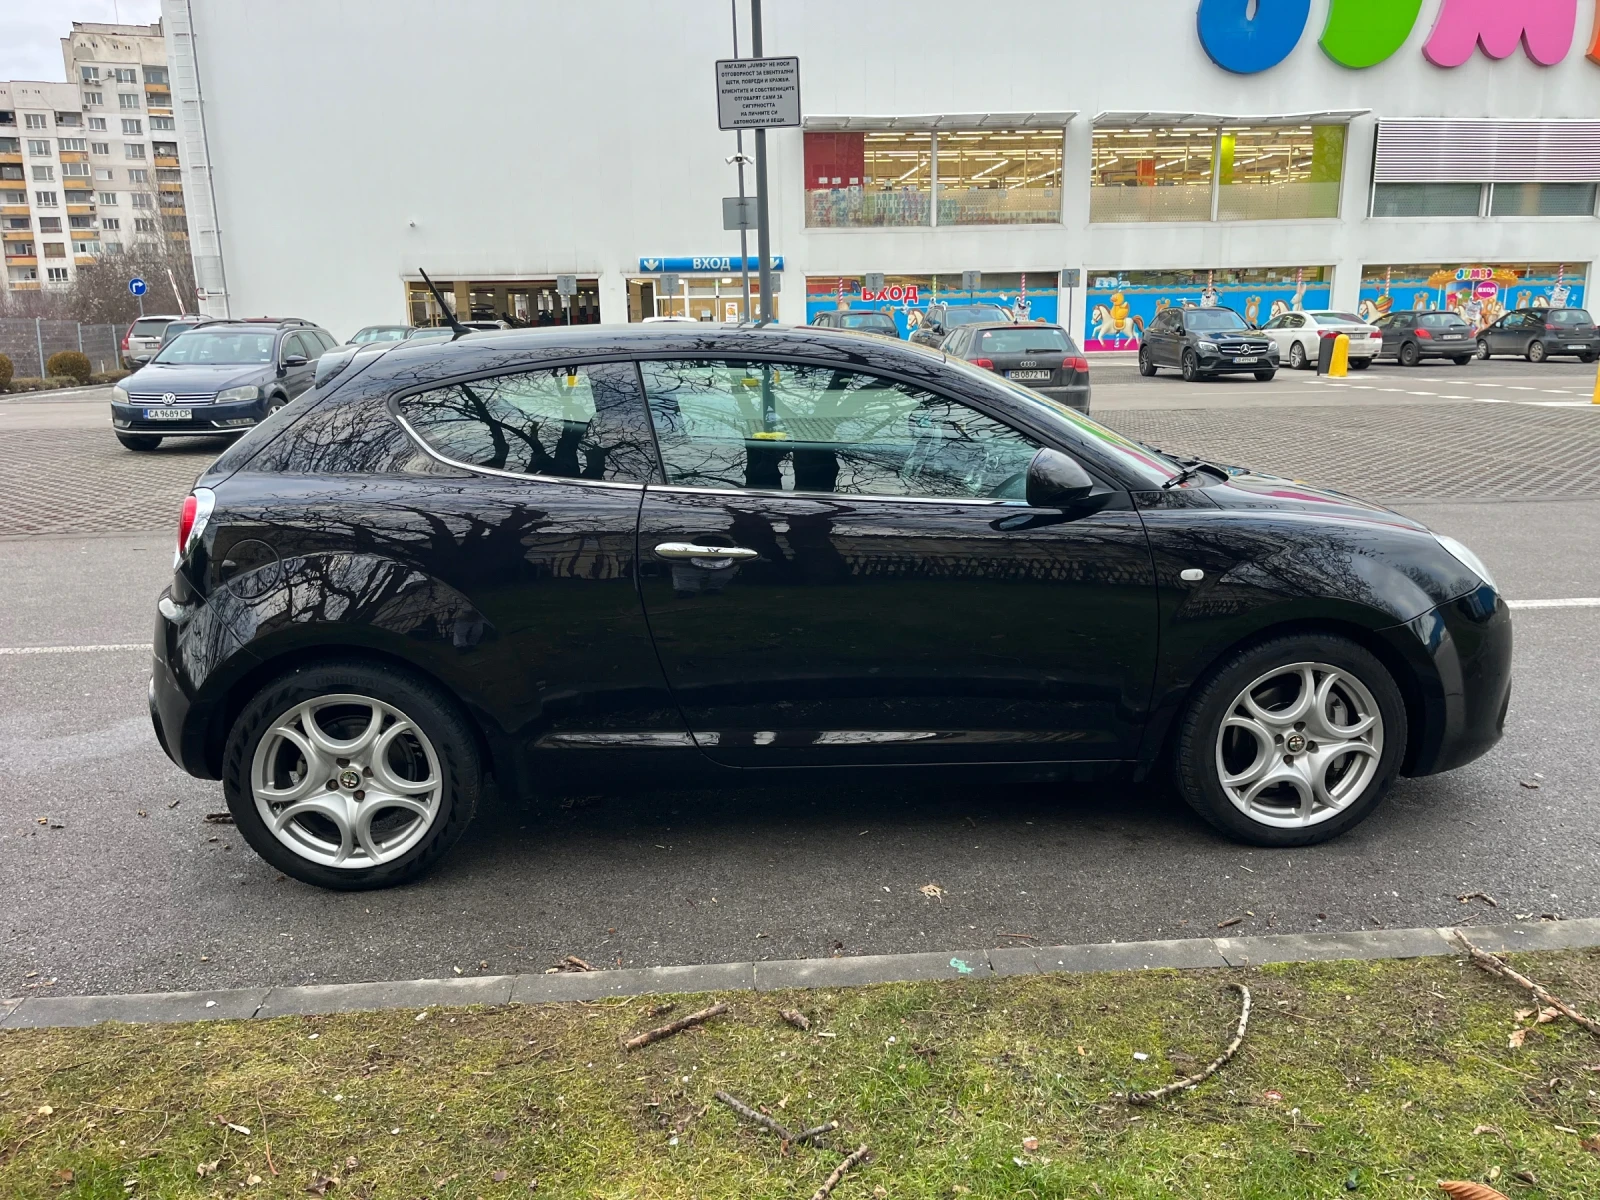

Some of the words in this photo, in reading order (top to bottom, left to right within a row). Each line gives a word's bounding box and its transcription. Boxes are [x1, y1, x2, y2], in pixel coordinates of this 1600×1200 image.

[693, 257, 731, 271] ВХОД
[1010, 370, 1019, 378] CB
[160, 410, 178, 418] 9689
